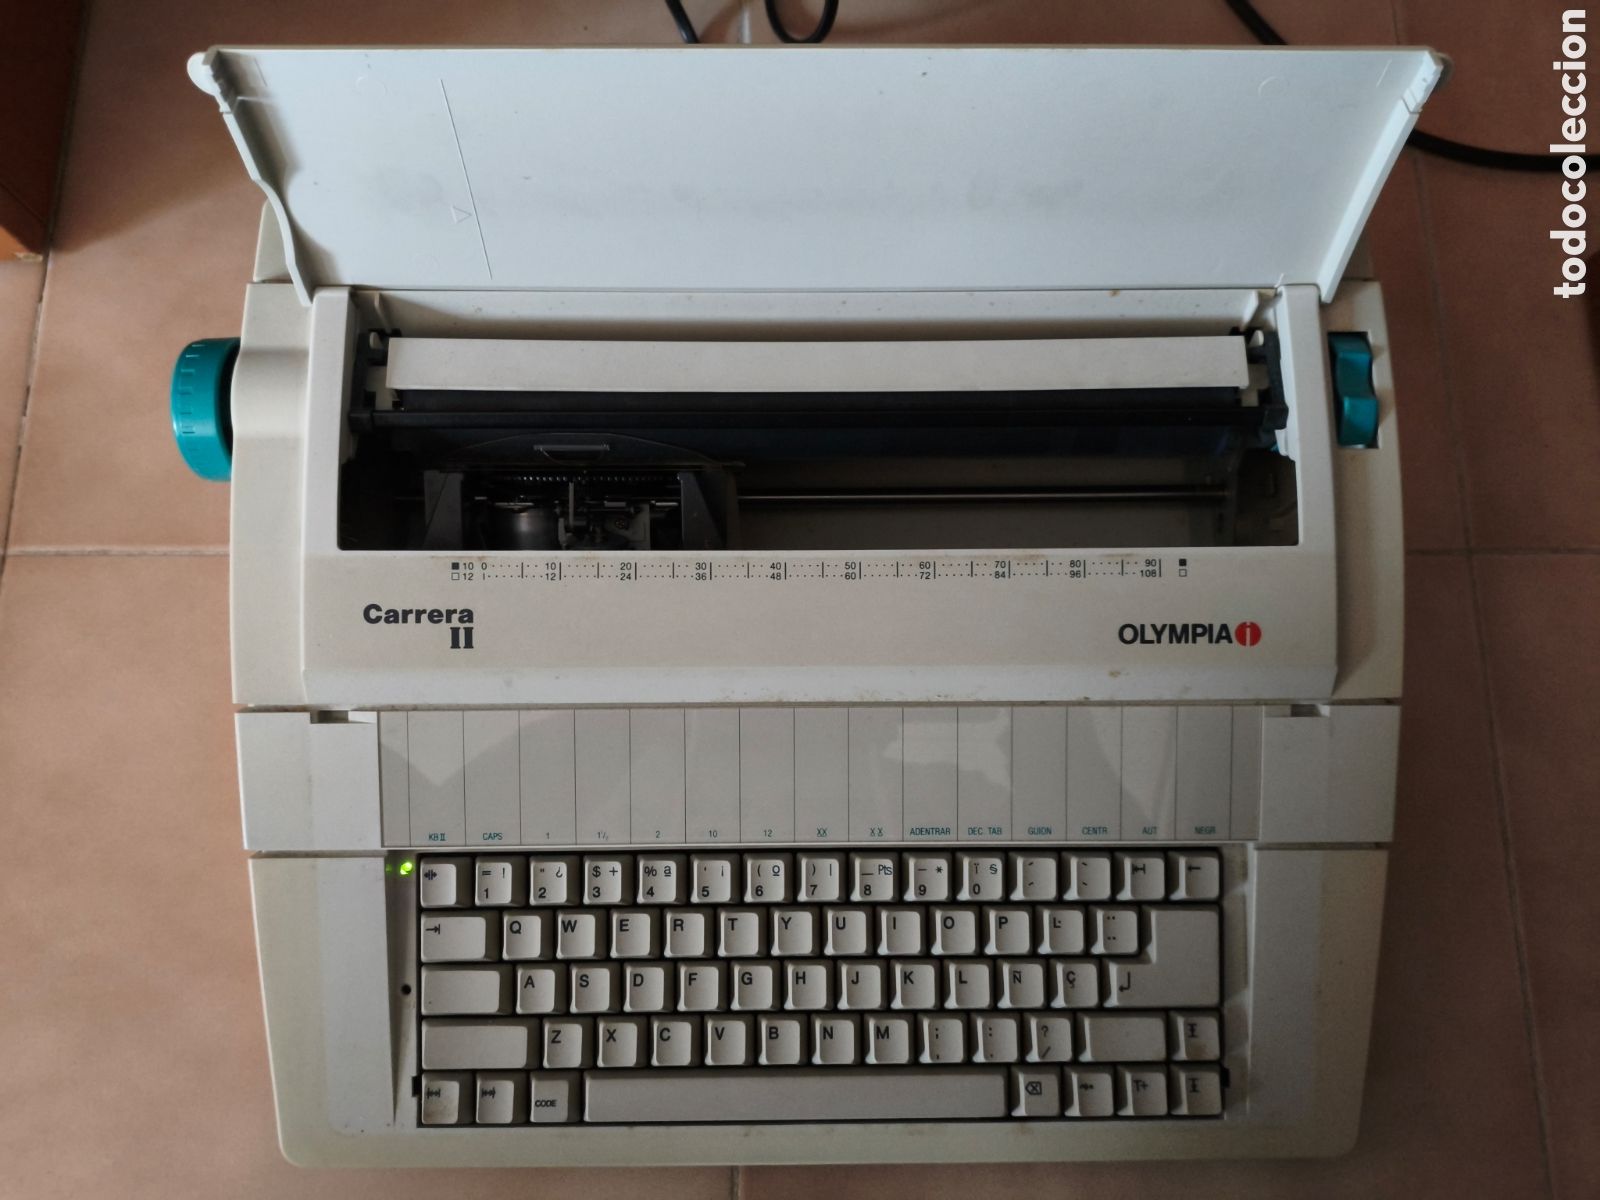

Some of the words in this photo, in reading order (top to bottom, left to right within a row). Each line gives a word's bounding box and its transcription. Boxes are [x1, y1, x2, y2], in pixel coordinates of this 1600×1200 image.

[462, 561, 474, 571] 10
[480, 561, 488, 571] 0
[545, 561, 557, 571] 10
[619, 561, 632, 571] 20
[695, 561, 707, 571] 30
[769, 561, 782, 571] 40
[844, 561, 857, 570] 50
[918, 561, 931, 570] 60
[994, 560, 1007, 569] 70
[1069, 559, 1082, 569] 80
[1144, 558, 1157, 568] 90
[462, 572, 474, 581] 12
[545, 572, 557, 581] 12
[619, 572, 632, 581] 24
[695, 572, 707, 581] 36
[769, 572, 782, 581] 48
[844, 571, 857, 581] 60
[919, 571, 931, 580] 72
[994, 570, 1006, 580] 84
[1069, 569, 1082, 579] 96
[1140, 568, 1157, 578] 108
[362, 603, 474, 625] Carrera
[1118, 623, 1234, 645] OLYMPIA
[482, 832, 503, 841] CAPS
[655, 830, 661, 839] 2
[708, 829, 718, 838] 10
[763, 829, 773, 838] 12
[909, 827, 951, 836] ADENTRAR
[1027, 826, 1052, 836] GUION
[1081, 826, 1108, 835] CENTR
[877, 863, 893, 876] Pts
[483, 887, 489, 899] 1
[537, 886, 547, 899] 2
[592, 886, 601, 899] 3
[645, 885, 655, 898] 4
[701, 885, 710, 898] 5
[754, 884, 764, 897] 6
[809, 884, 818, 896] 7
[863, 884, 872, 896] 8
[917, 884, 927, 897] 9
[508, 920, 522, 935] Q
[560, 919, 578, 934] W
[619, 918, 630, 933] E
[672, 918, 685, 932] R
[727, 917, 739, 932] T
[780, 916, 792, 931] Y
[835, 916, 846, 931] U
[892, 916, 897, 931] I
[942, 915, 955, 930] O
[997, 915, 1009, 930] P
[523, 975, 536, 990] A
[578, 973, 590, 988] S
[632, 972, 644, 988] D
[687, 972, 698, 987] F
[740, 971, 753, 986] G
[795, 971, 806, 985] H
[850, 971, 860, 985] J
[903, 970, 914, 985] K
[957, 969, 968, 985] L
[1012, 970, 1022, 985] Ñ
[1065, 970, 1076, 989] Ç
[550, 1029, 562, 1045] Z
[605, 1028, 617, 1043] X
[659, 1027, 671, 1042] C
[714, 1026, 725, 1041] V
[768, 1025, 780, 1041] B
[822, 1025, 834, 1041] N
[875, 1025, 890, 1040] M
[534, 1099, 557, 1108] CODE
